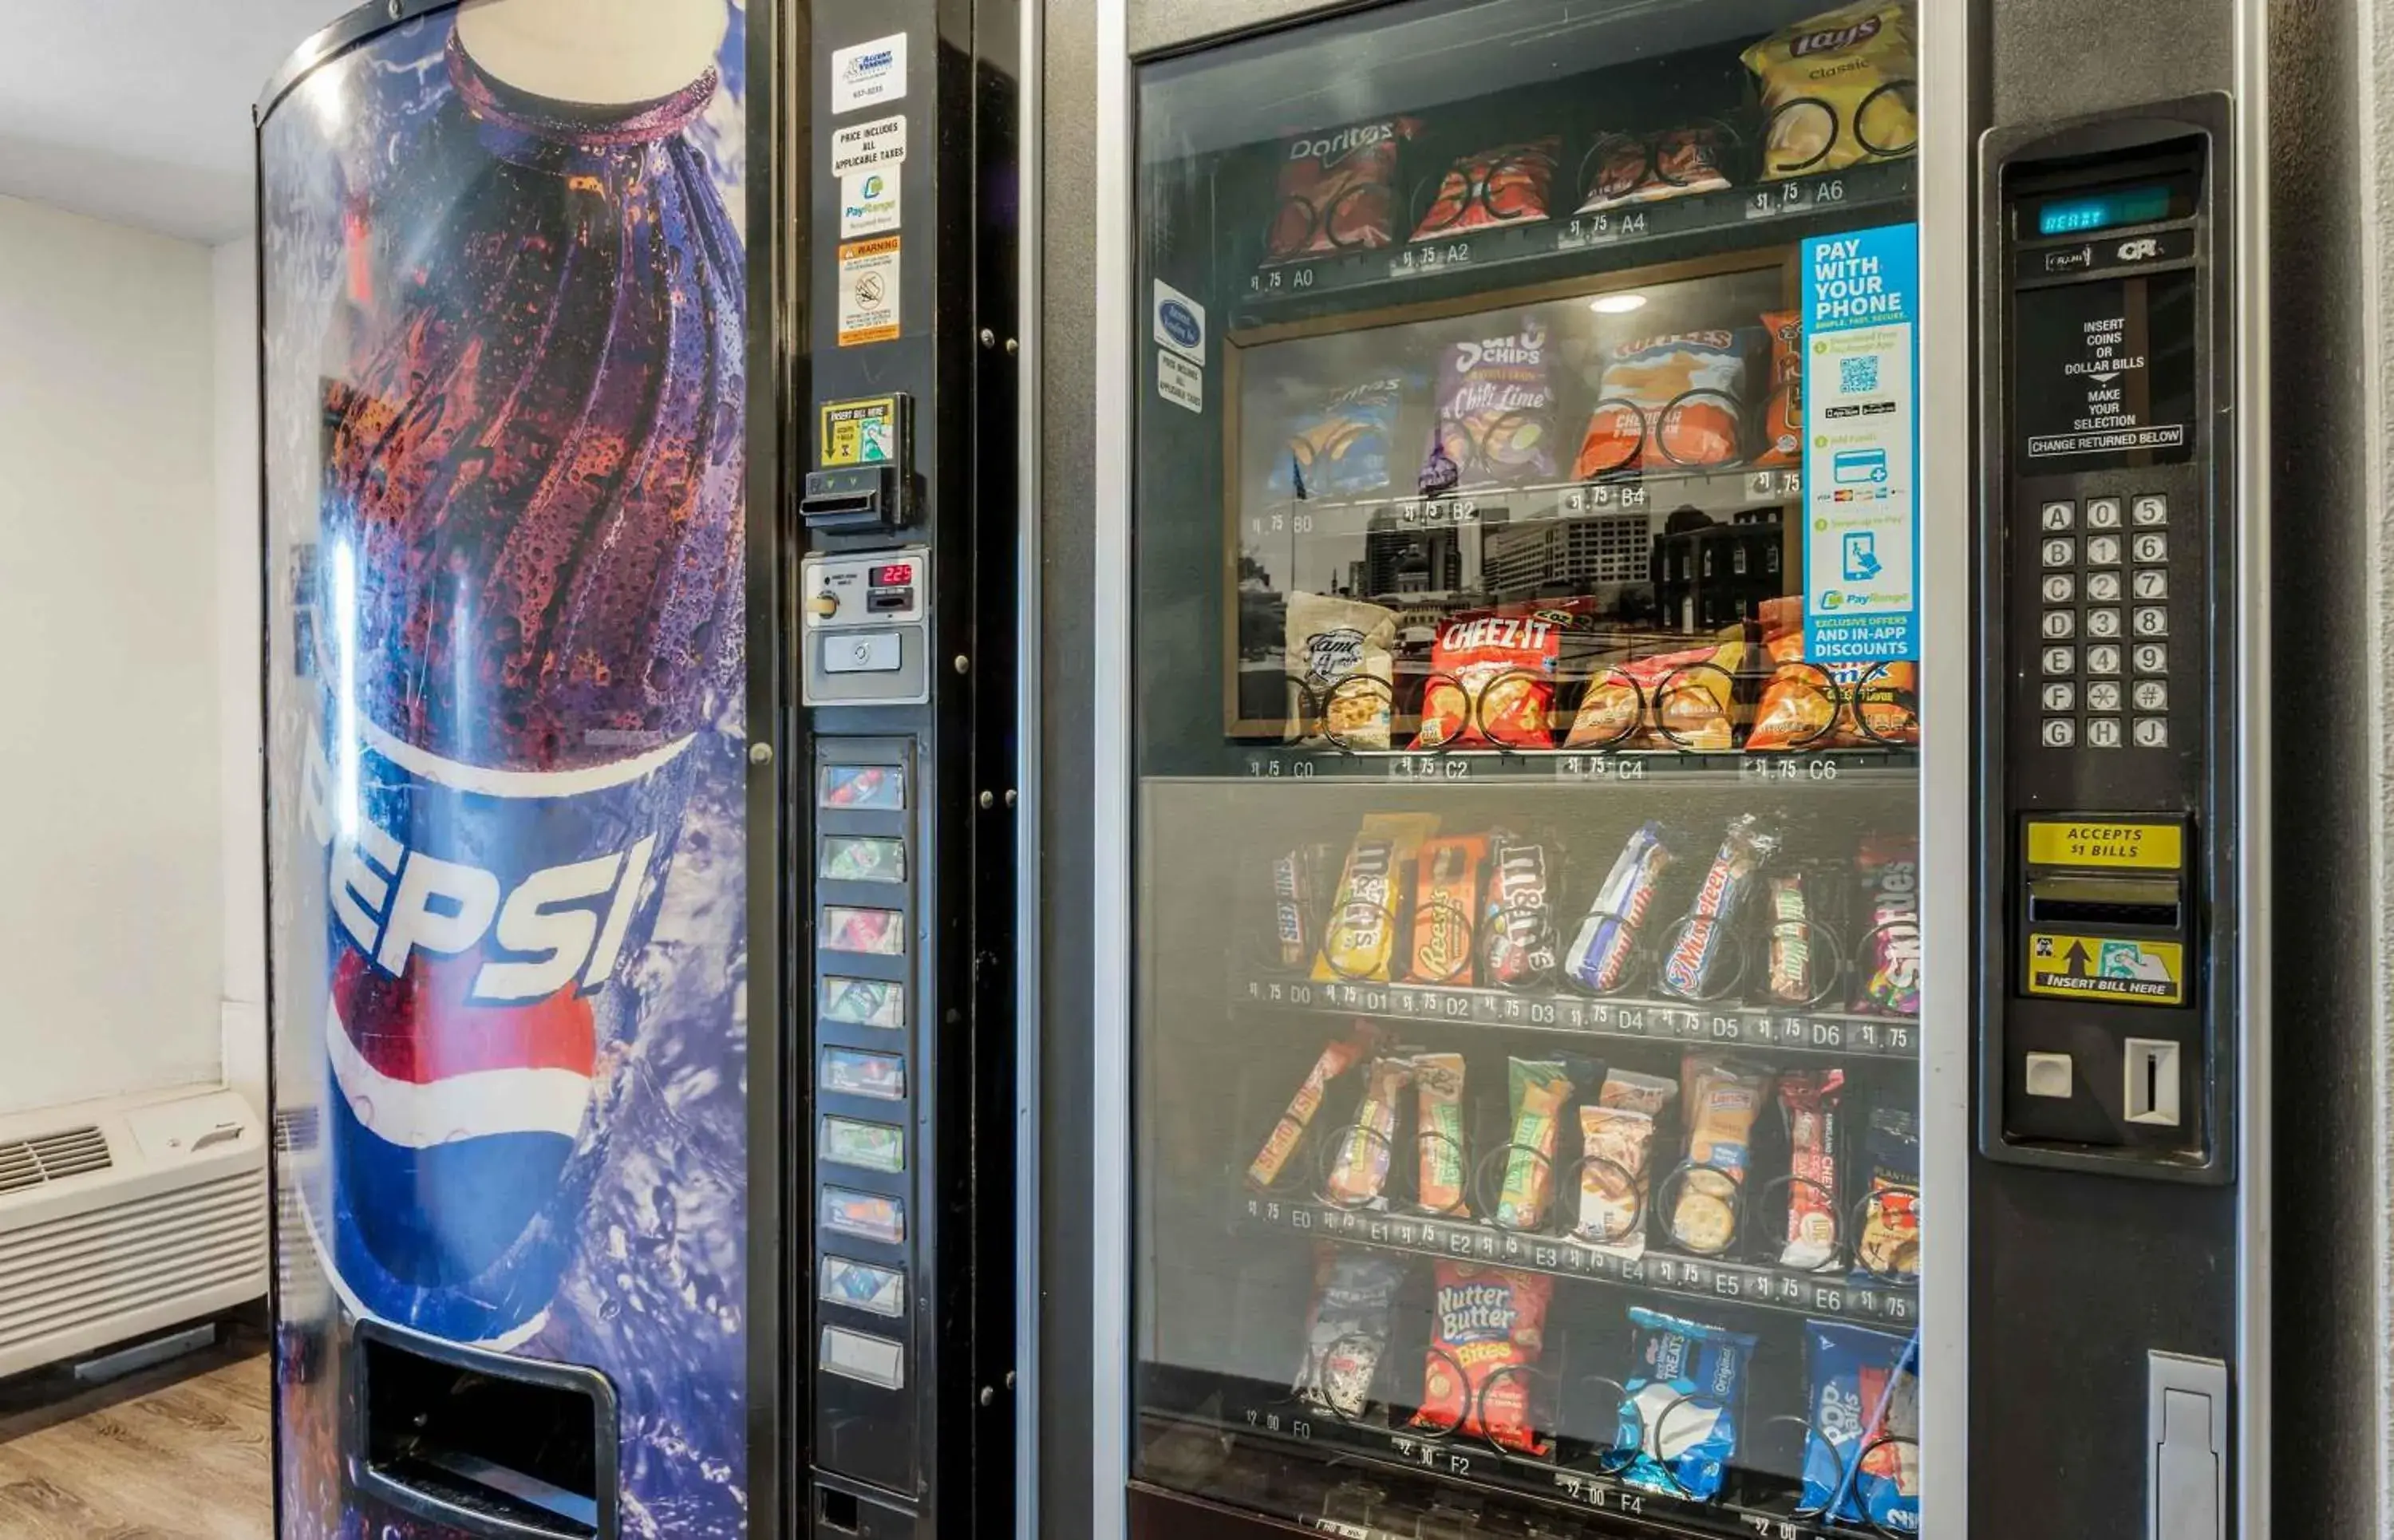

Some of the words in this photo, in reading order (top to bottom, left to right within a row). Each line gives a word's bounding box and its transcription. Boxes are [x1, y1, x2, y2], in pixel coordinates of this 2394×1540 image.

[1808, 57, 1871, 81] Classic
[841, 131, 861, 143] PRICE
[864, 122, 898, 138] INCLUDES
[1290, 122, 1393, 160] Doritos
[863, 142, 875, 151] ALL
[836, 153, 877, 170] APPLICABLE
[880, 147, 904, 160] TAXES
[1816, 180, 1843, 202] A6
[846, 199, 895, 218] PayRange
[1622, 215, 1645, 233] A4
[858, 239, 898, 255] WARNING
[1447, 243, 1468, 263] A2
[1815, 239, 1860, 262] PAY
[1294, 269, 1313, 287] A0
[1815, 257, 1878, 281] WITH
[1815, 276, 1882, 300] YOUR
[1816, 293, 1902, 320] PHONE
[2084, 318, 2124, 333] INSERT
[2087, 333, 2122, 346] COINS
[1483, 349, 1542, 365] CHIPS
[2096, 346, 2112, 357] OR
[2065, 361, 2109, 375] DOLLAR
[2112, 357, 2144, 369] BILLS
[1455, 383, 1493, 419] Chili
[1495, 385, 1543, 411] Lime
[2088, 389, 2120, 402] MAKE
[831, 411, 852, 421] INSERT
[853, 409, 866, 418] BILL
[867, 406, 883, 416] HERE
[2088, 402, 2119, 415] YOUR
[2074, 414, 2136, 430] SELECTION
[2033, 437, 2075, 453] CHANGE
[2078, 433, 2137, 450] RETURNED
[2139, 429, 2180, 445] BELOW
[1622, 486, 1644, 507] B4
[1452, 503, 1474, 519] B2
[2050, 507, 2064, 526] A
[2096, 504, 2109, 523] 0
[2143, 501, 2155, 520] 5
[1294, 516, 1313, 533] B0
[2051, 543, 2064, 563] B
[2099, 542, 2108, 560] 1
[2143, 539, 2155, 557] 6
[2051, 578, 2064, 598] C
[2096, 577, 2110, 596] 2
[2143, 575, 2155, 594] 7
[1847, 592, 1908, 606] PayRange
[1815, 617, 1867, 628] EXCLUSIVE
[2052, 615, 2065, 634] D
[2096, 614, 2109, 633] 3
[2143, 612, 2155, 631] 8
[1816, 628, 1849, 642] AND
[1852, 626, 1906, 640] IN-APP
[1815, 642, 1908, 657] DISCOUNTS
[2143, 649, 2155, 668] 9
[2052, 651, 2064, 670] E
[2096, 650, 2108, 669] 4
[2052, 688, 2064, 706] F
[2141, 686, 2157, 705] #
[2052, 724, 2065, 743] G
[2096, 724, 2110, 743] H
[2143, 723, 2155, 742] J
[1446, 760, 1468, 779] C2
[1620, 760, 1642, 780] C4
[1810, 760, 1836, 780] C6
[2068, 828, 2142, 840] ACCEPTS
[2071, 844, 2085, 856] $1
[2092, 845, 2139, 857] BILLS
[1677, 859, 1730, 971] Musketeers
[2047, 974, 2096, 990] INSERT
[2098, 978, 2127, 993] BILL
[2130, 981, 2166, 996] HERE
[1447, 998, 1468, 1016] D2
[1532, 1004, 1555, 1023] D3
[1619, 1011, 1642, 1029] D4
[1713, 1017, 1738, 1037] D5
[1813, 1025, 1839, 1044] D6
[1293, 1211, 1311, 1228] E0
[1372, 1223, 1388, 1242] E1
[1450, 1237, 1470, 1253] E2
[1536, 1248, 1556, 1266] E3
[1623, 1262, 1643, 1280] E4
[1716, 1276, 1738, 1295] E5
[1439, 1286, 1511, 1315] Nutter
[1816, 1289, 1841, 1310] E6
[1443, 1306, 1515, 1341] Butter
[1458, 1342, 1511, 1364] Bites
[1665, 1335, 1685, 1380] TREATS
[1714, 1348, 1732, 1394] Original
[1451, 1455, 1469, 1475] F2
[1621, 1495, 1642, 1514] F4
